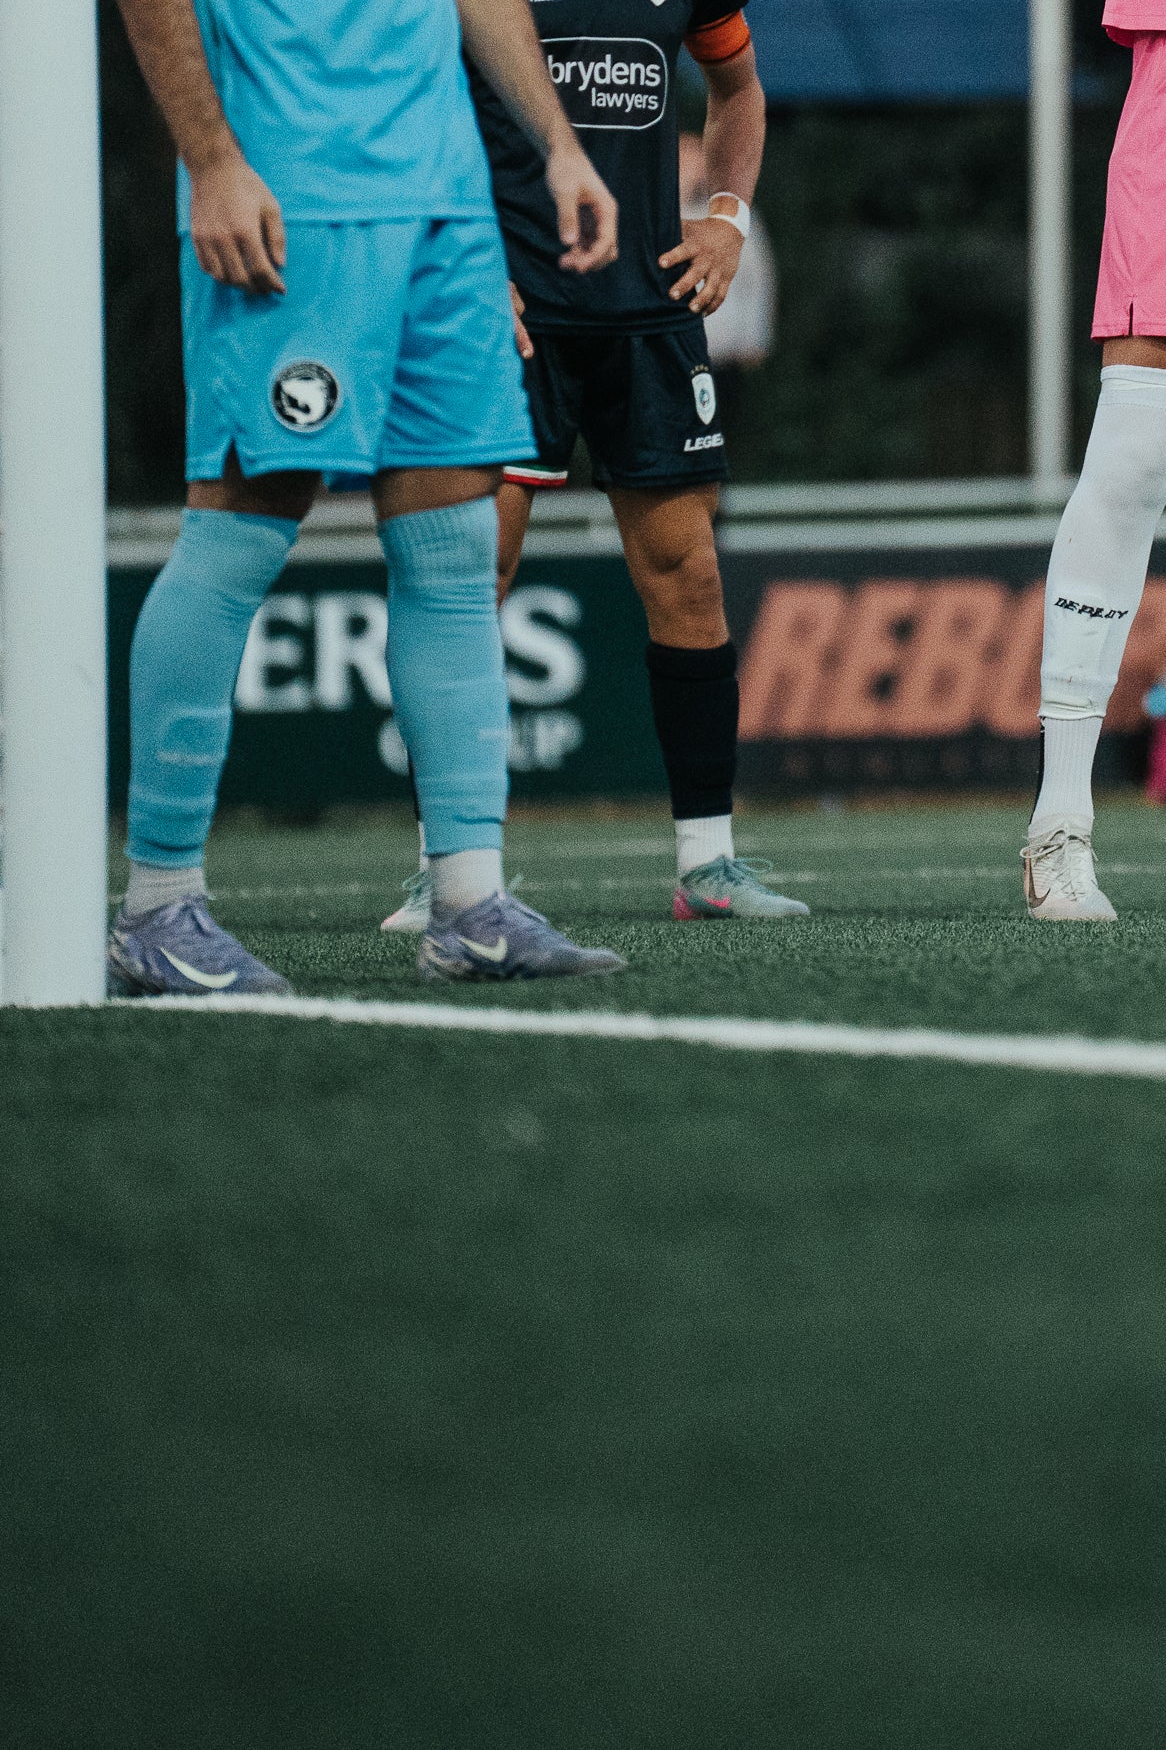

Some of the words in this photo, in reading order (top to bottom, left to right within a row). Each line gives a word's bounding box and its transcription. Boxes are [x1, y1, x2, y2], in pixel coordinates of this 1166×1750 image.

[548, 54, 661, 91] brydens
[591, 88, 658, 113] lawyers
[684, 433, 724, 452] LEGE
[1054, 597, 1128, 619] DEPLOY
